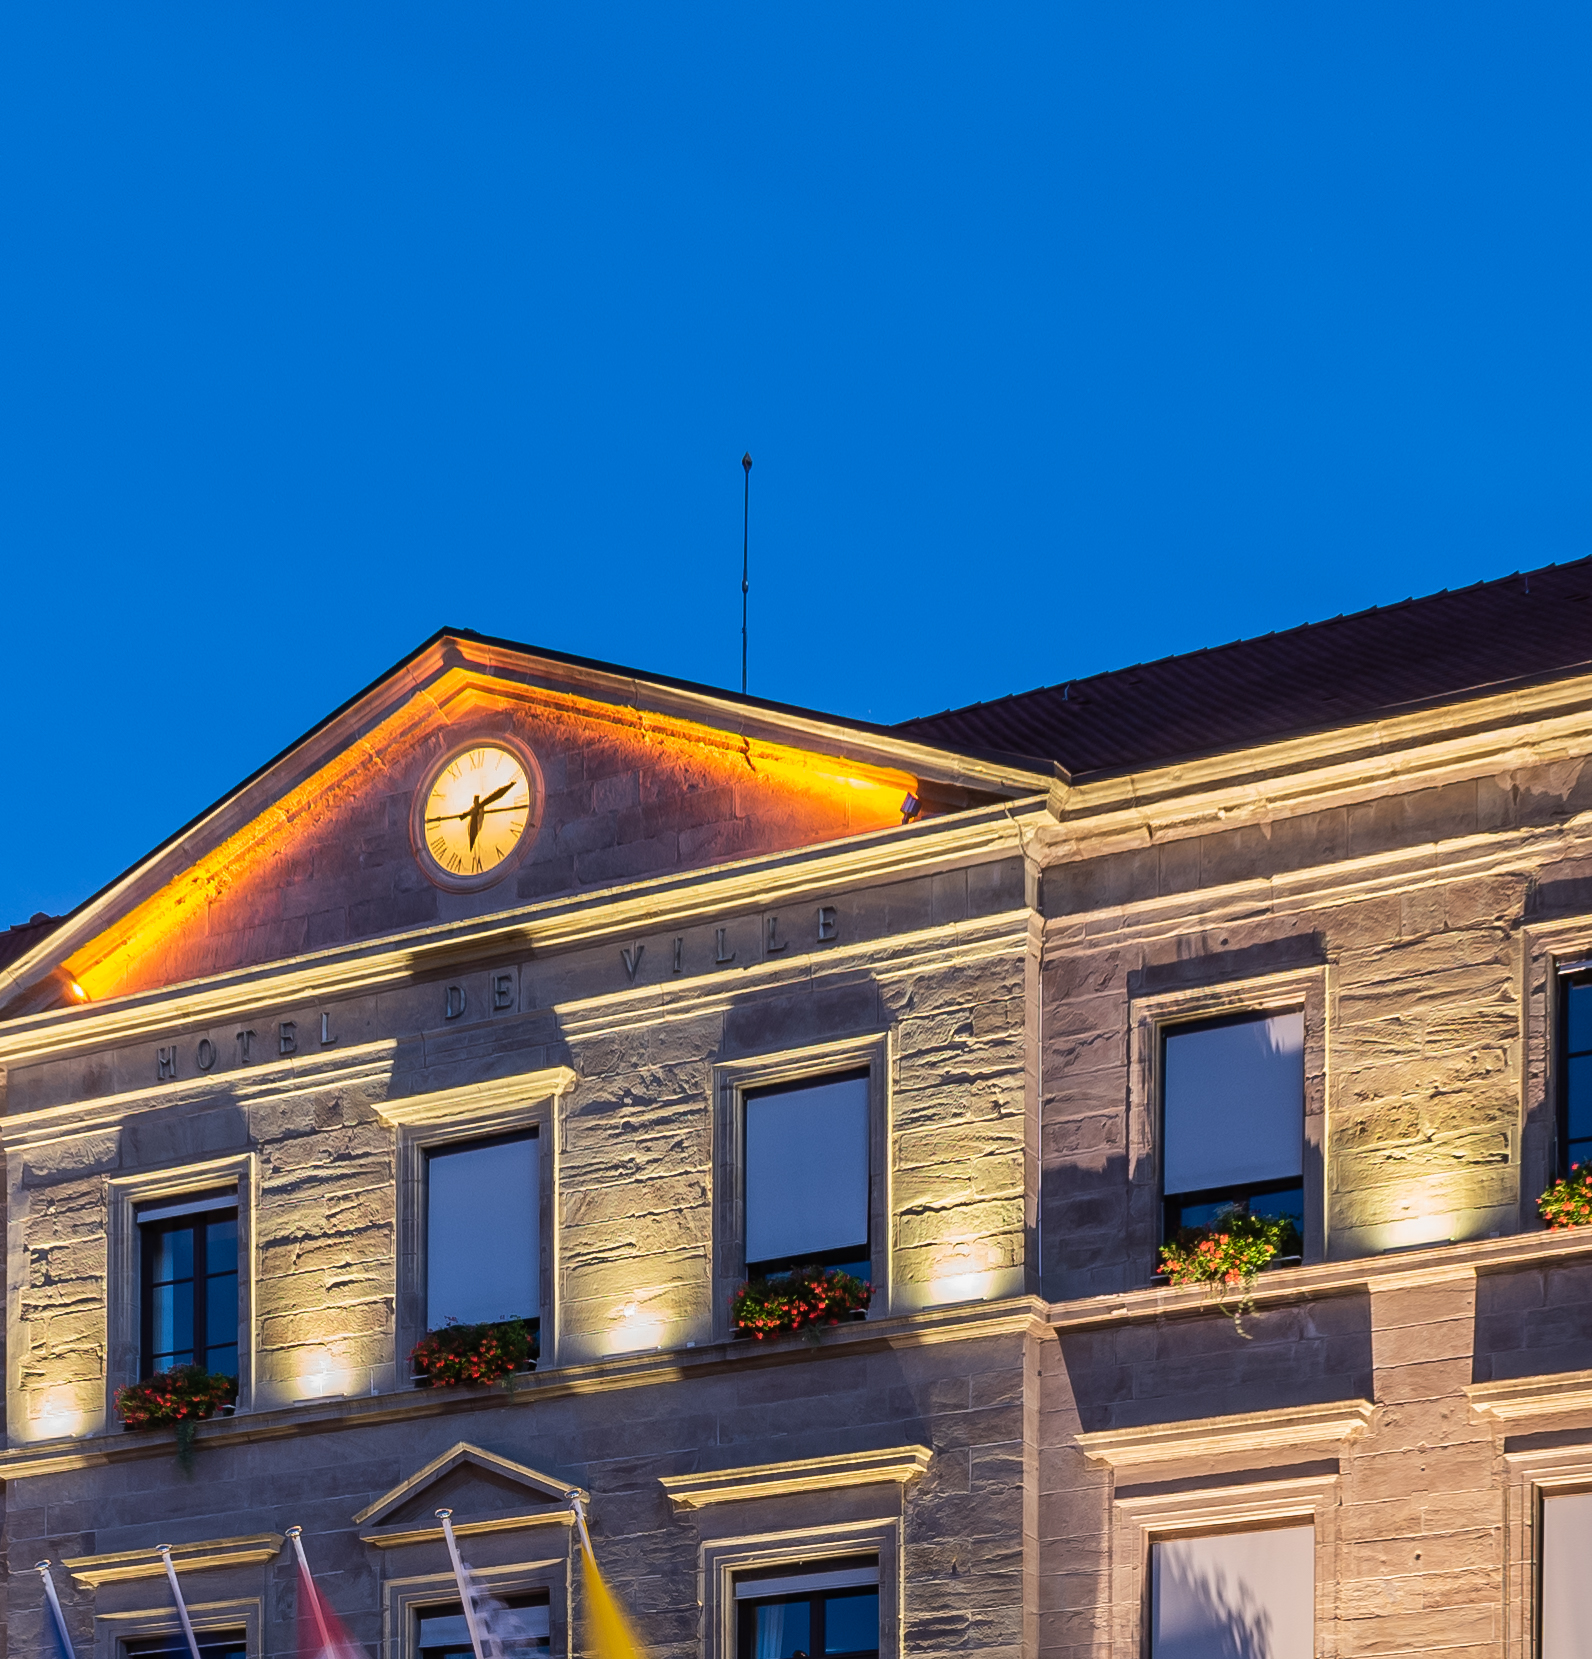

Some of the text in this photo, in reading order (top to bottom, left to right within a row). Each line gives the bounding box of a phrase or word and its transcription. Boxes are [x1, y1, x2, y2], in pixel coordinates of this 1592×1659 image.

[157, 905, 839, 1081] HOTEL DE VILLE
